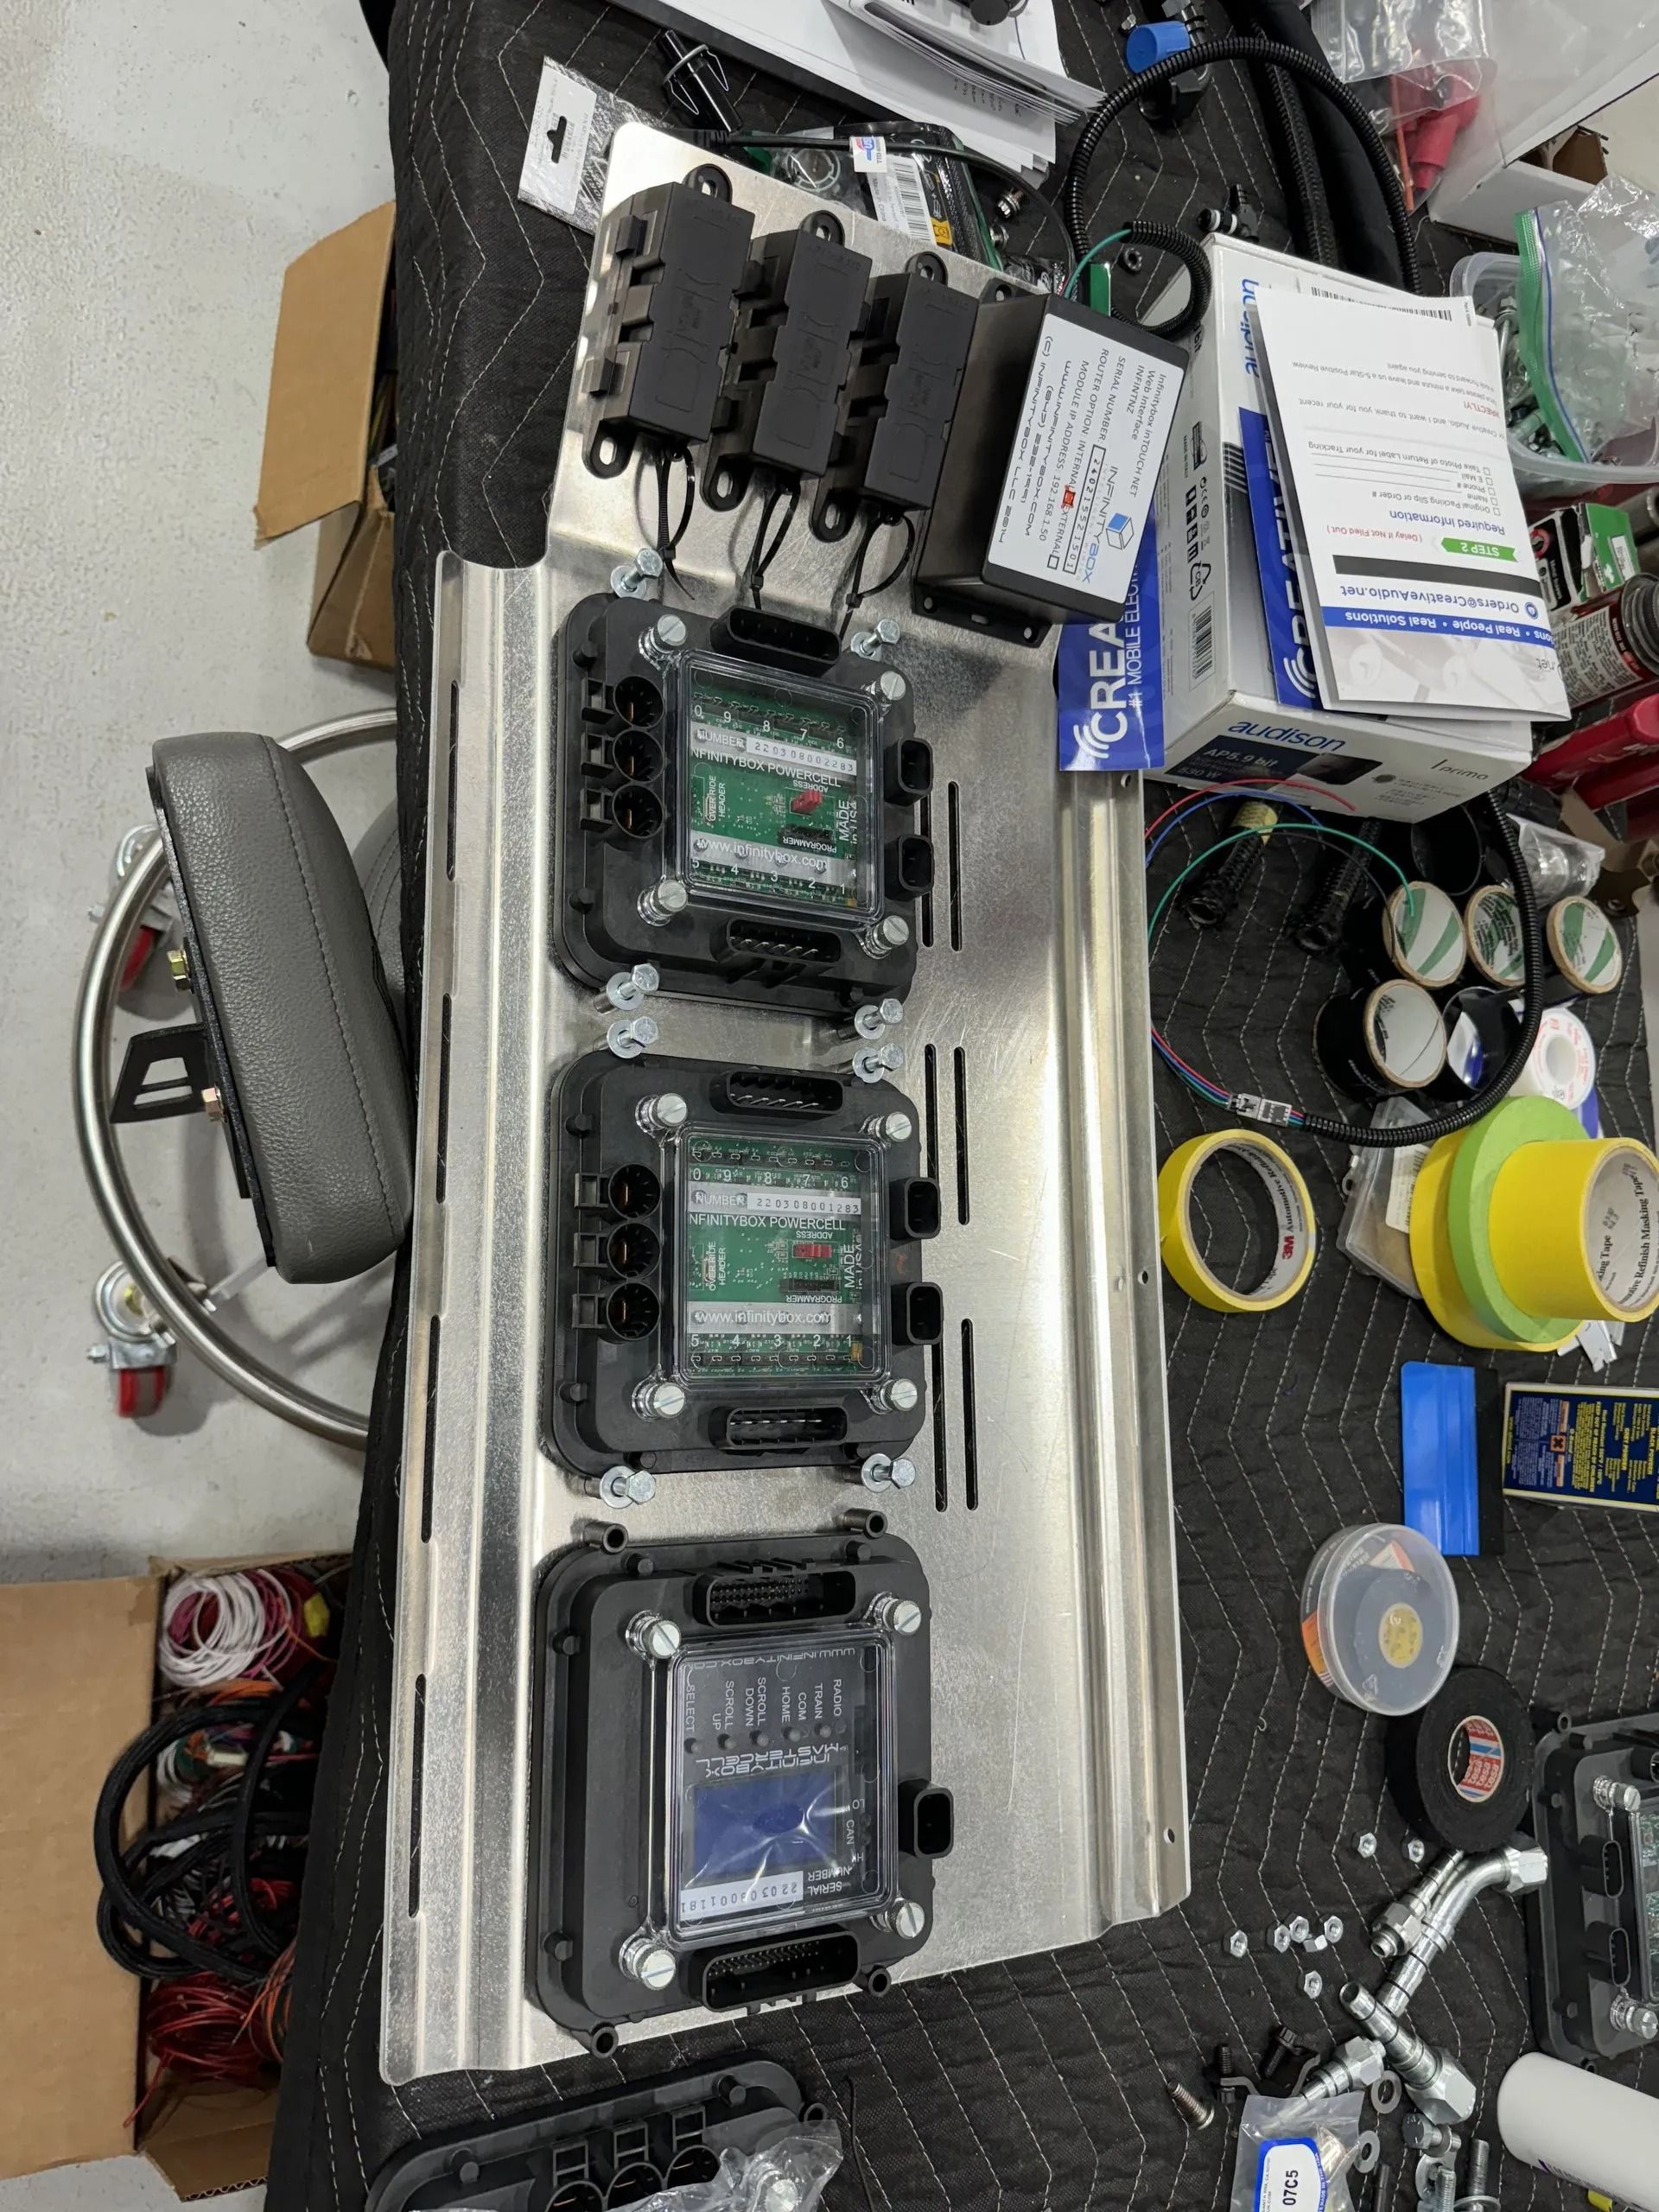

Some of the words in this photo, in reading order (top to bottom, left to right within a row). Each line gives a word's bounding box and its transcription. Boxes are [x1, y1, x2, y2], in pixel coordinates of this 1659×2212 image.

[1090, 347, 1109, 392] ROUTER
[1109, 356, 1126, 391] SERIAL
[1141, 369, 1154, 393] Web
[1319, 365, 1348, 375] Positive
[1070, 359, 1089, 408] MODULE
[1126, 365, 1144, 413] INFINTNZ
[1017, 361, 1046, 461] INFINITYBOX
[1144, 372, 1166, 428] Infinitybox
[1298, 397, 1323, 408] recent
[1326, 399, 1343, 410] your
[1344, 404, 1357, 412] for
[1357, 404, 1373, 414] you
[1067, 410, 1077, 420] IP
[1079, 393, 1097, 438] OPTION:
[1096, 393, 1116, 444] NUMBER:
[1130, 395, 1148, 440] Interface
[1374, 408, 1395, 418] thank
[1408, 413, 1427, 422] want
[1471, 424, 1496, 436] Creative
[1054, 421, 1074, 473] ADDRESS:
[1134, 429, 1152, 474] inTOUCH
[1307, 440, 1344, 454] Tracking
[1344, 444, 1363, 455] your
[1365, 448, 1377, 457] for
[1378, 450, 1401, 461] Label
[1066, 439, 1086, 491] INTERNAL
[1402, 454, 1428, 465] Return
[1439, 459, 1462, 470] Photo
[1463, 462, 1480, 473] Take
[1007, 466, 1021, 500] LLC
[1128, 476, 1140, 497] NET
[1378, 490, 1402, 500] Order
[1462, 481, 1485, 493] Phone
[1038, 474, 1060, 541] 192.168.1.50
[1412, 494, 1427, 504] Slip
[1427, 496, 1460, 509] Packing
[1462, 501, 1491, 513] Original
[1466, 492, 1488, 502] Name
[997, 505, 1011, 543] 2014
[1051, 503, 1071, 556] EXTERNAL
[1081, 465, 1119, 584] INFINITYBOX
[1389, 508, 1454, 529] Information
[1456, 517, 1505, 536] Required
[1371, 529, 1386, 538] Not
[1459, 541, 1466, 551] 2
[1468, 543, 1500, 556] STEP
[1339, 585, 1518, 611] Orders@CreativeAudio.net
[1345, 610, 1406, 626] Solutions
[1409, 616, 1436, 627] Real
[1452, 619, 1492, 633] People
[1495, 625, 1520, 635] Real
[1126, 626, 1141, 683] MOBILE
[1088, 619, 1128, 742] CREA
[1128, 692, 1141, 707] #1
[696, 728, 745, 748] NUMBER
[721, 710, 732, 723] 9
[761, 719, 771, 732] 8
[798, 728, 807, 741] 7
[836, 736, 845, 748] 6
[1228, 719, 1346, 754] audison
[690, 747, 766, 772] NFINITYBOX
[767, 763, 842, 787] POWERCELL
[1203, 747, 1253, 762] AP5.9
[1254, 757, 1279, 767] bit
[792, 779, 828, 793] ADDRESS
[715, 782, 728, 817] HEADER
[839, 800, 849, 840] MADE
[696, 835, 829, 870] www.infinitybox.com
[782, 836, 837, 853] PROGRAMMER
[691, 855, 700, 868] 5
[730, 862, 740, 874] 4
[770, 870, 779, 881] 3
[808, 877, 817, 888] 2
[839, 883, 846, 894] 1
[723, 1169, 731, 1181] 9
[764, 1171, 772, 1184] 8
[802, 1174, 810, 1186] 7
[840, 1176, 849, 1188] 6
[1630, 1176, 1643, 1196] Tape
[696, 1195, 747, 1205] NUMBER
[1273, 1178, 1296, 1234] Automotive
[689, 1214, 766, 1226] NFINITYBOX
[769, 1217, 845, 1230] POWERCELL
[1639, 1198, 1649, 1240] Masking
[1281, 1235, 1294, 1261] 3M
[1599, 1234, 1614, 1260] Tape
[717, 1247, 727, 1284] HEADER
[842, 1243, 855, 1287] MADE
[1634, 1241, 1650, 1279] Refinish
[786, 1294, 842, 1303] PROGRAMMER
[696, 1308, 830, 1325] www.infinitybox.com
[691, 1333, 698, 1346] 5
[733, 1334, 741, 1346] 4
[774, 1334, 781, 1346] 3
[813, 1334, 821, 1346] 2
[846, 1335, 851, 1347] 1
[684, 1684, 696, 1732] SELECT
[723, 1680, 734, 1730] SCROLL
[744, 1688, 754, 1726] DOWN
[755, 1676, 766, 1726] SCROLL
[780, 1686, 791, 1722] HOME
[797, 1692, 807, 1720] COM
[813, 1683, 823, 1719] TRAIN
[832, 1679, 842, 1716] RADIO
[711, 1713, 721, 1730] UP
[696, 1742, 839, 1768] MASTERCELL
[1476, 1761, 1491, 1787] tesa
[1484, 1763, 1499, 1789] tesa
[845, 1820, 855, 1844] CAN
[807, 1865, 849, 1880] NUMBER
[807, 1880, 842, 1895] SERIAL
[1282, 2169, 1299, 2205] 07C5
